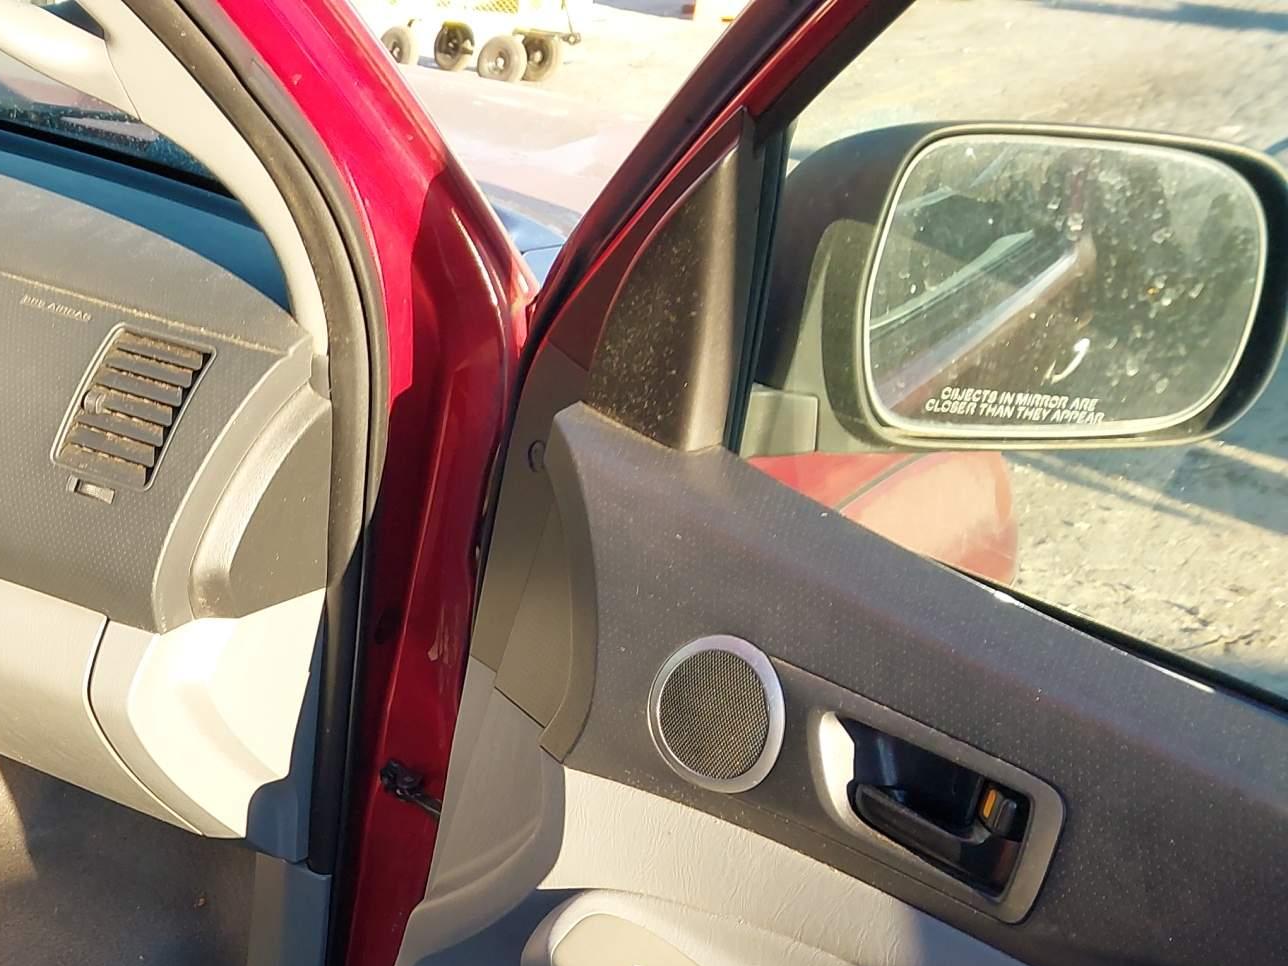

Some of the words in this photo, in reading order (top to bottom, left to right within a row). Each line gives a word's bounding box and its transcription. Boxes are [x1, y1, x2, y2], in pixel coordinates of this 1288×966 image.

[924, 398, 978, 416] CLOSER
[979, 402, 1016, 418] THAN
[1016, 406, 1052, 421] THEY
[1050, 408, 1105, 425] APPEAR
[940, 386, 999, 404] OBJECTS
[999, 391, 1016, 406] IN
[1015, 392, 1069, 409] MIRROR
[1070, 397, 1100, 412] ARE
